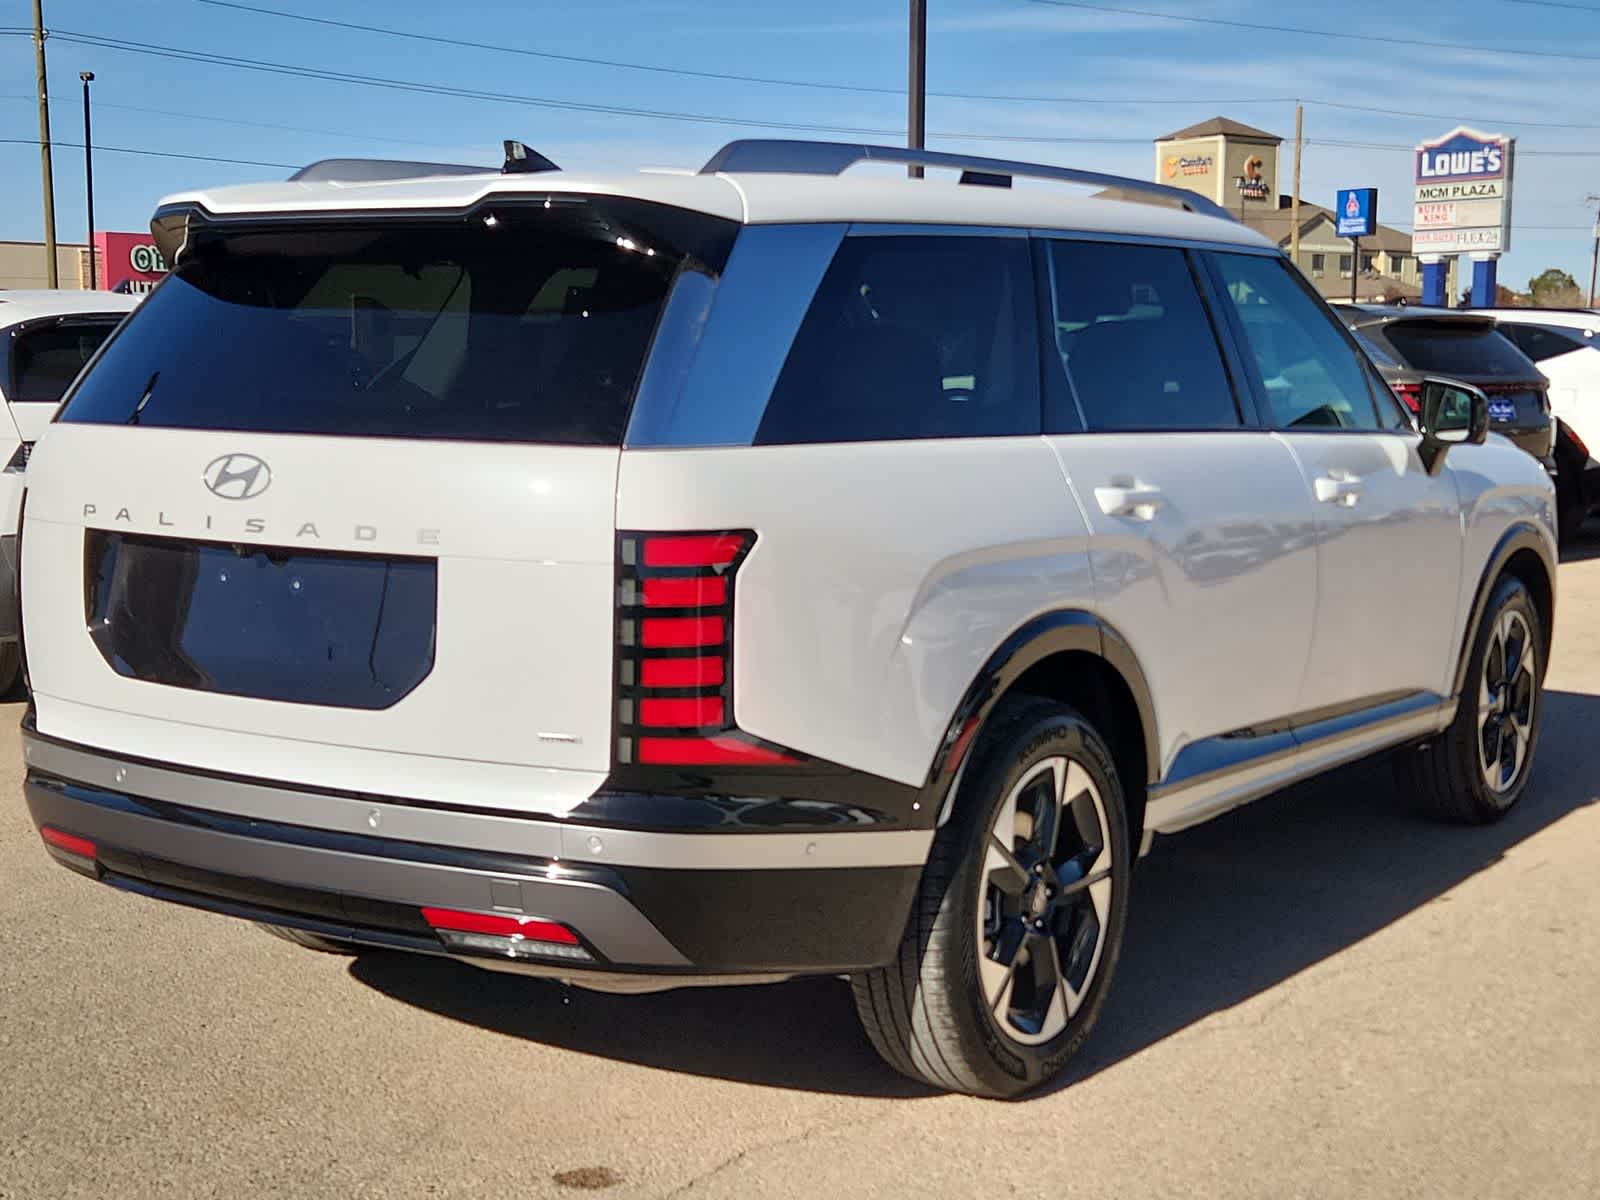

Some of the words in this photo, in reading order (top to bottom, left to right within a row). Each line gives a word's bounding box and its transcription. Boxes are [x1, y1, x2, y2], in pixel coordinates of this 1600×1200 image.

[1421, 146, 1501, 177] LOWE'S
[1419, 187, 1449, 199] MCM
[1452, 184, 1496, 197] PLAZA
[83, 503, 441, 545] PALISADE
